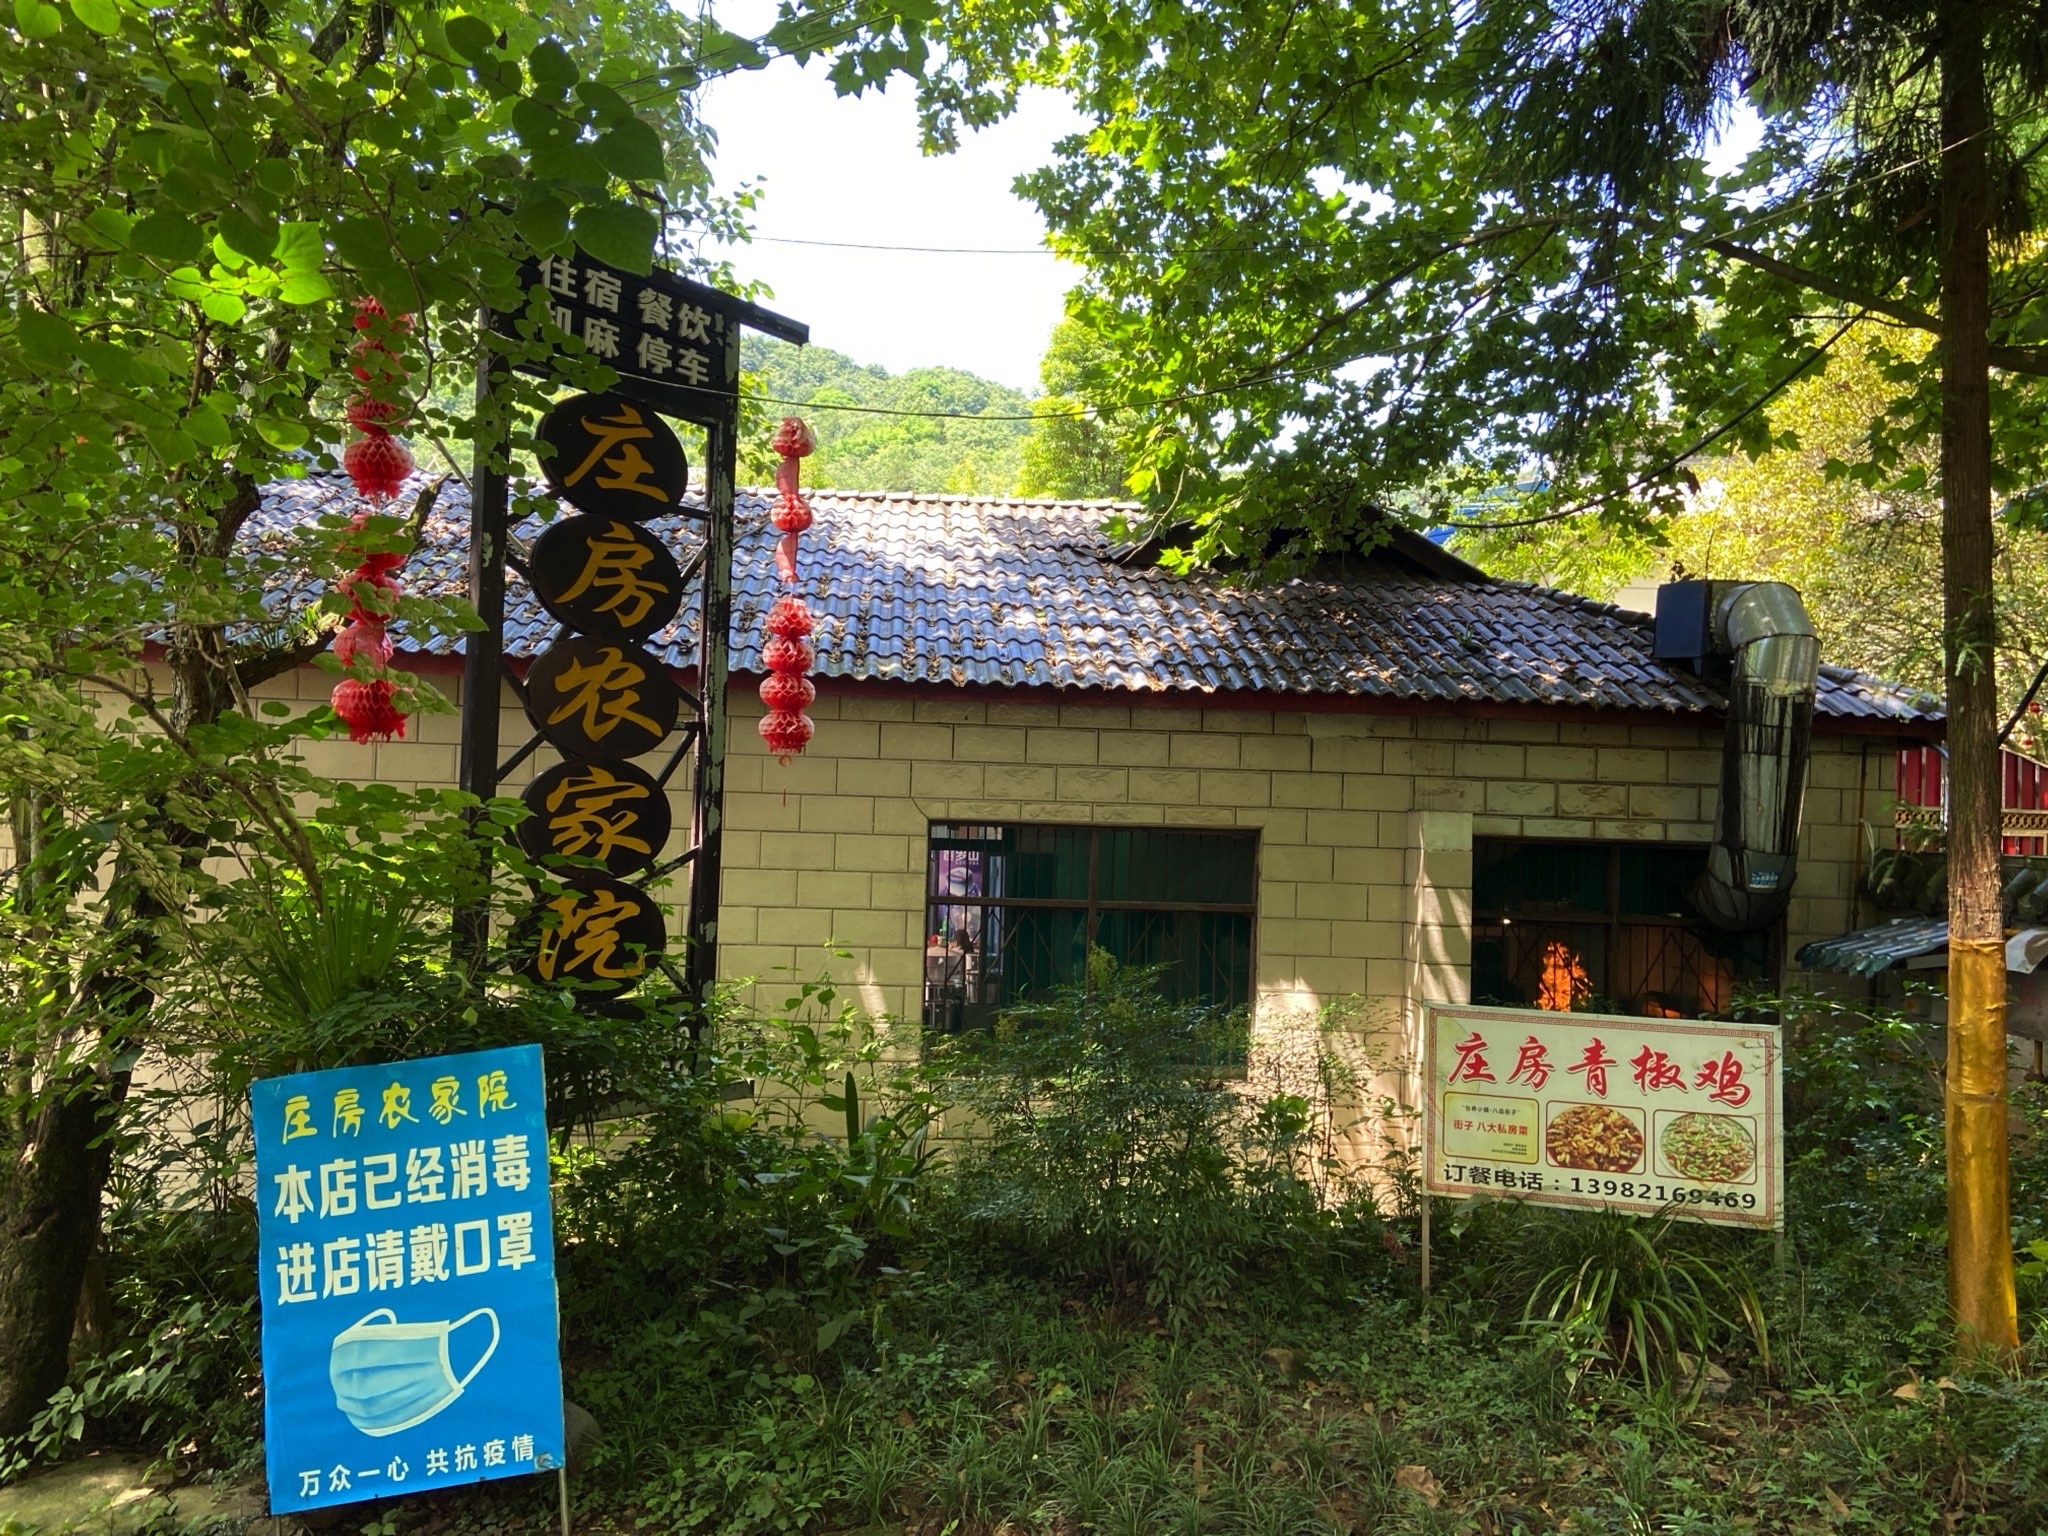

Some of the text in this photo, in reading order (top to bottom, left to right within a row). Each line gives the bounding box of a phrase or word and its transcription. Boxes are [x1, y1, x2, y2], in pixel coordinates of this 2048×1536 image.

[538, 253, 711, 346] 住宿 餐饮
[636, 332, 710, 385] 停车
[538, 403, 669, 981] 庄房农家院
[281, 1070, 517, 1145] 庄房农家院
[1448, 1032, 1753, 1108] 庄房青椒鸡
[1453, 1119, 1529, 1137] 街子 八大私房菜
[274, 1134, 531, 1224] 本店已经消毒
[276, 1211, 537, 1306] 进店请戴口罩
[297, 1433, 535, 1498] 万众一心 共抗疫情
